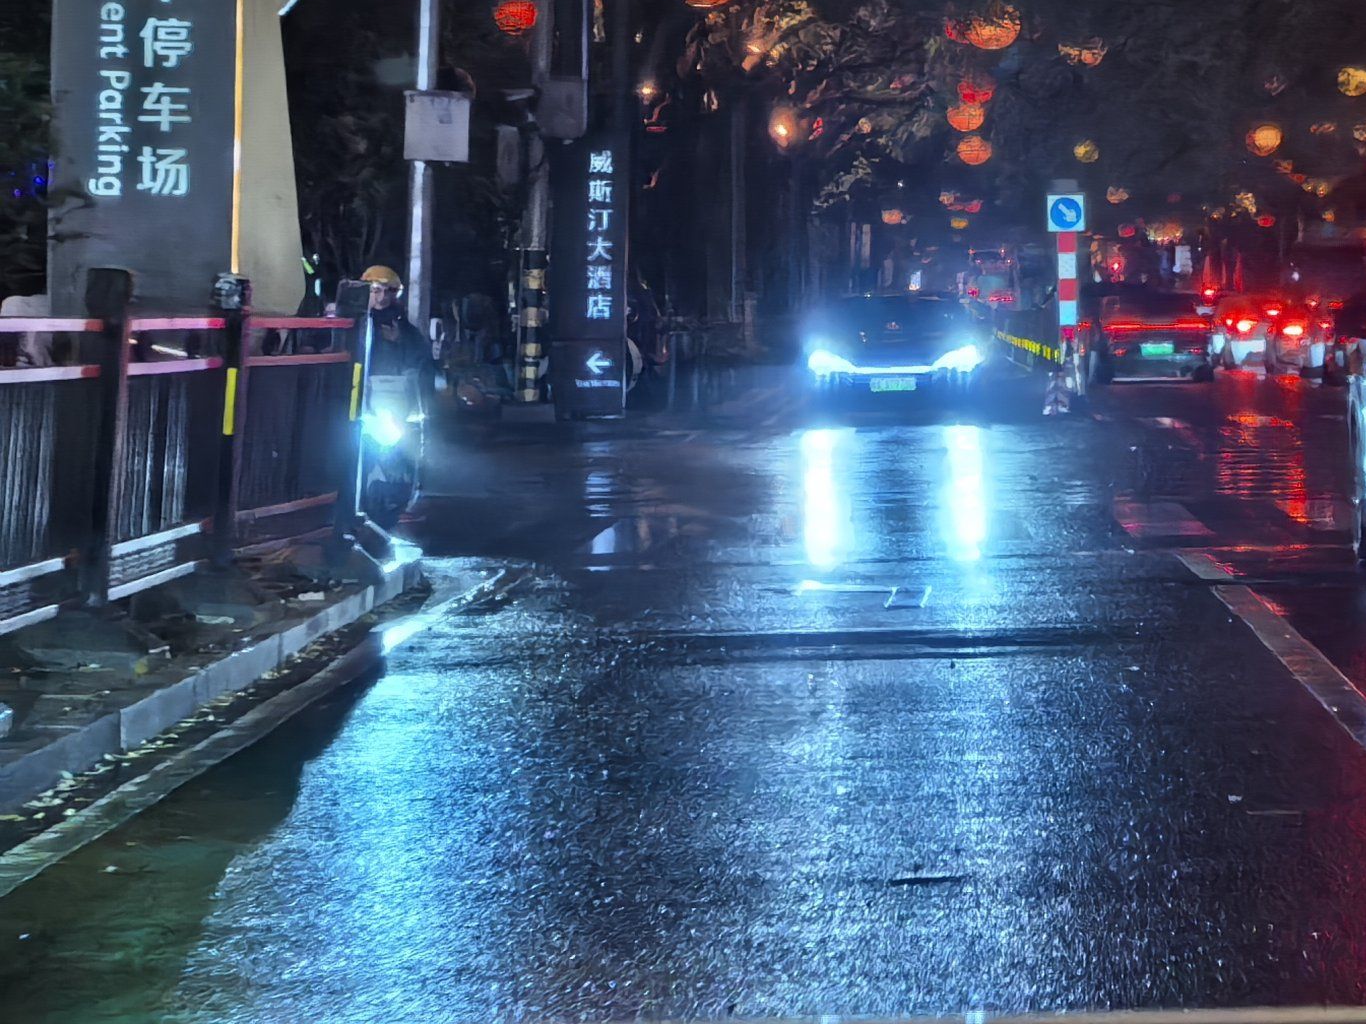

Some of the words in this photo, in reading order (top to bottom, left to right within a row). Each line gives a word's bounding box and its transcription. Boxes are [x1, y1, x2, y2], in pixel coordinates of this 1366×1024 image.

[87, 69, 133, 197] Parking
[586, 150, 614, 320] 威斯汀大酒店
